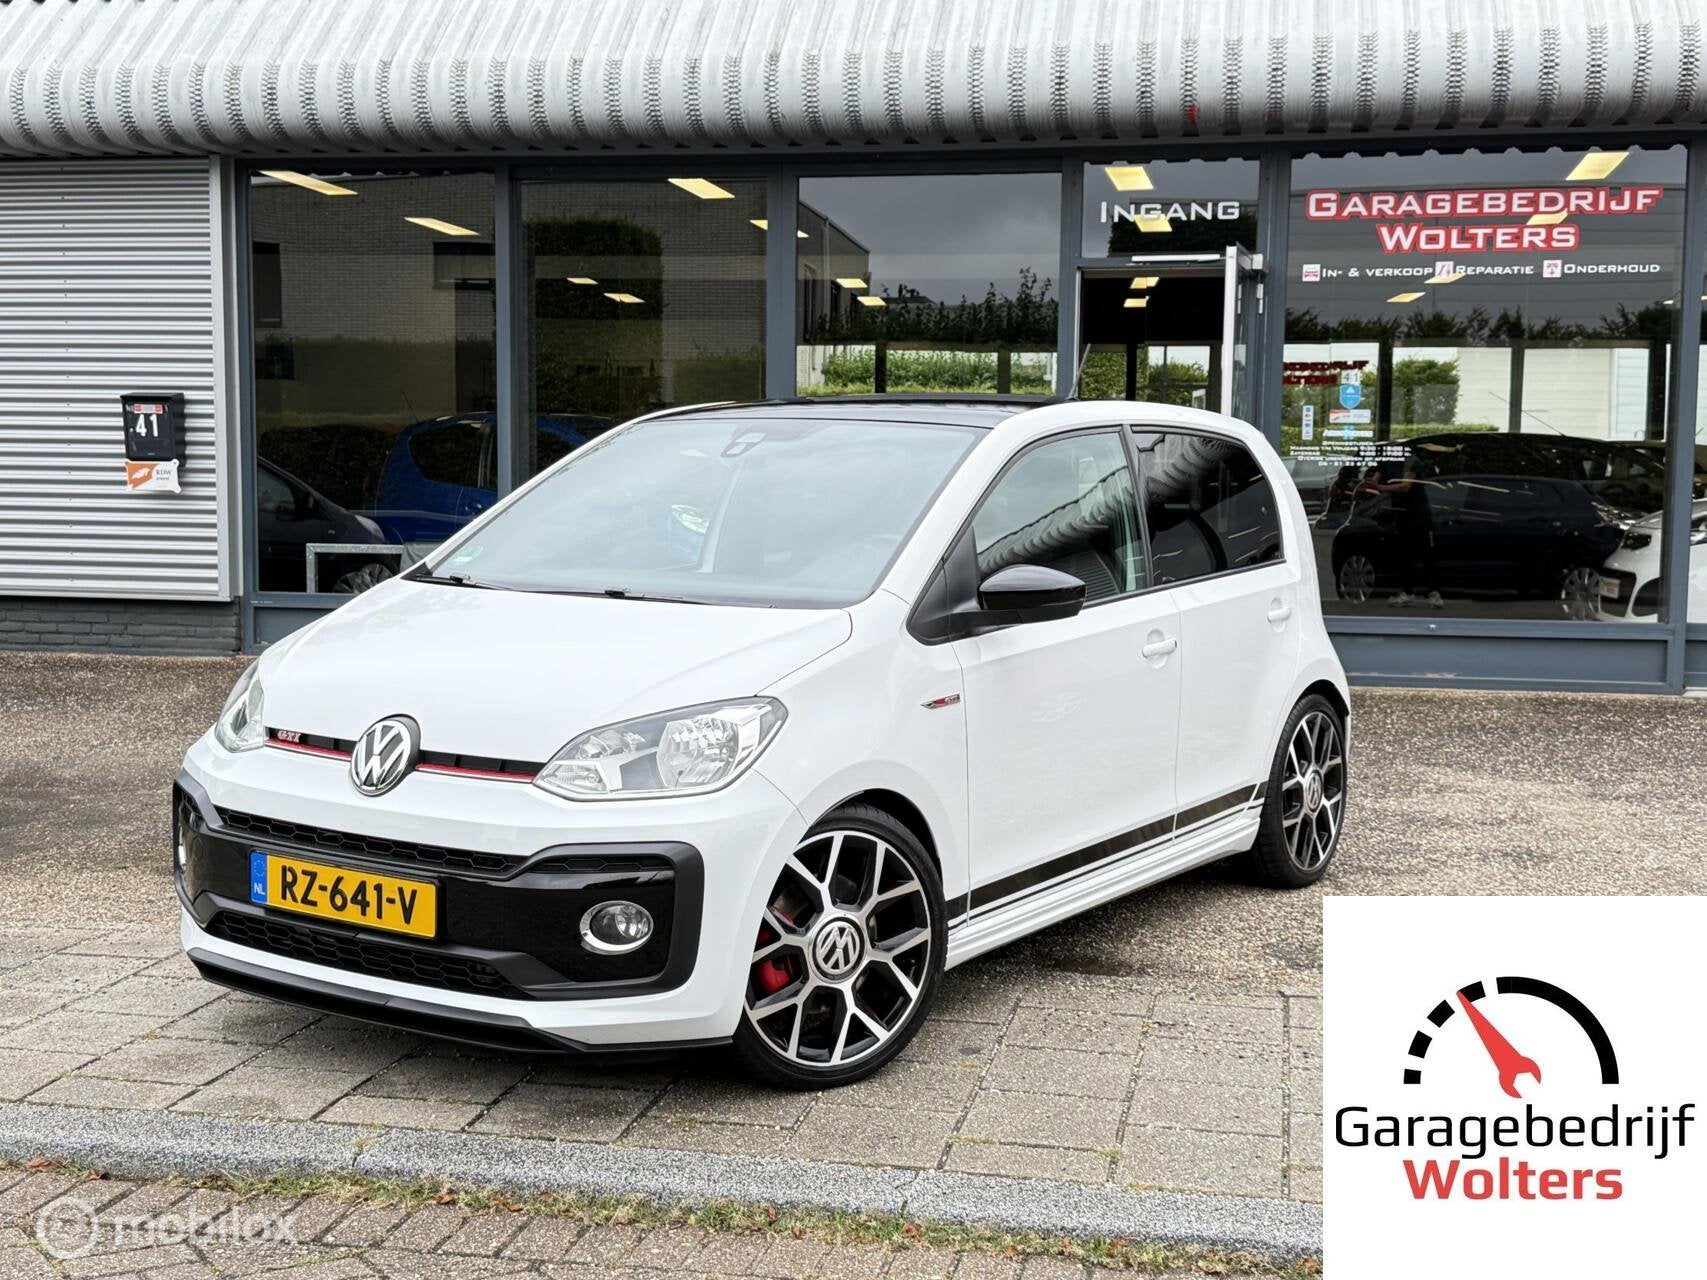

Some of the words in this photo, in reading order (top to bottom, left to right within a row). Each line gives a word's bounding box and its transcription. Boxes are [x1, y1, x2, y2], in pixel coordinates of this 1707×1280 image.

[1100, 201, 1240, 223] INGANG
[1307, 188, 1662, 219] GARAGEBEDRIJF
[1377, 224, 1579, 252] WOLTERS
[1348, 267, 1360, 277] &
[1366, 267, 1434, 277] VERKOOP
[1456, 265, 1534, 275] REPARATIE
[1564, 264, 1661, 274] ONDERHOUD
[1342, 372, 1359, 383] 41
[135, 413, 159, 437] 41
[254, 882, 266, 895] NL
[280, 864, 417, 925] RZ-641-V
